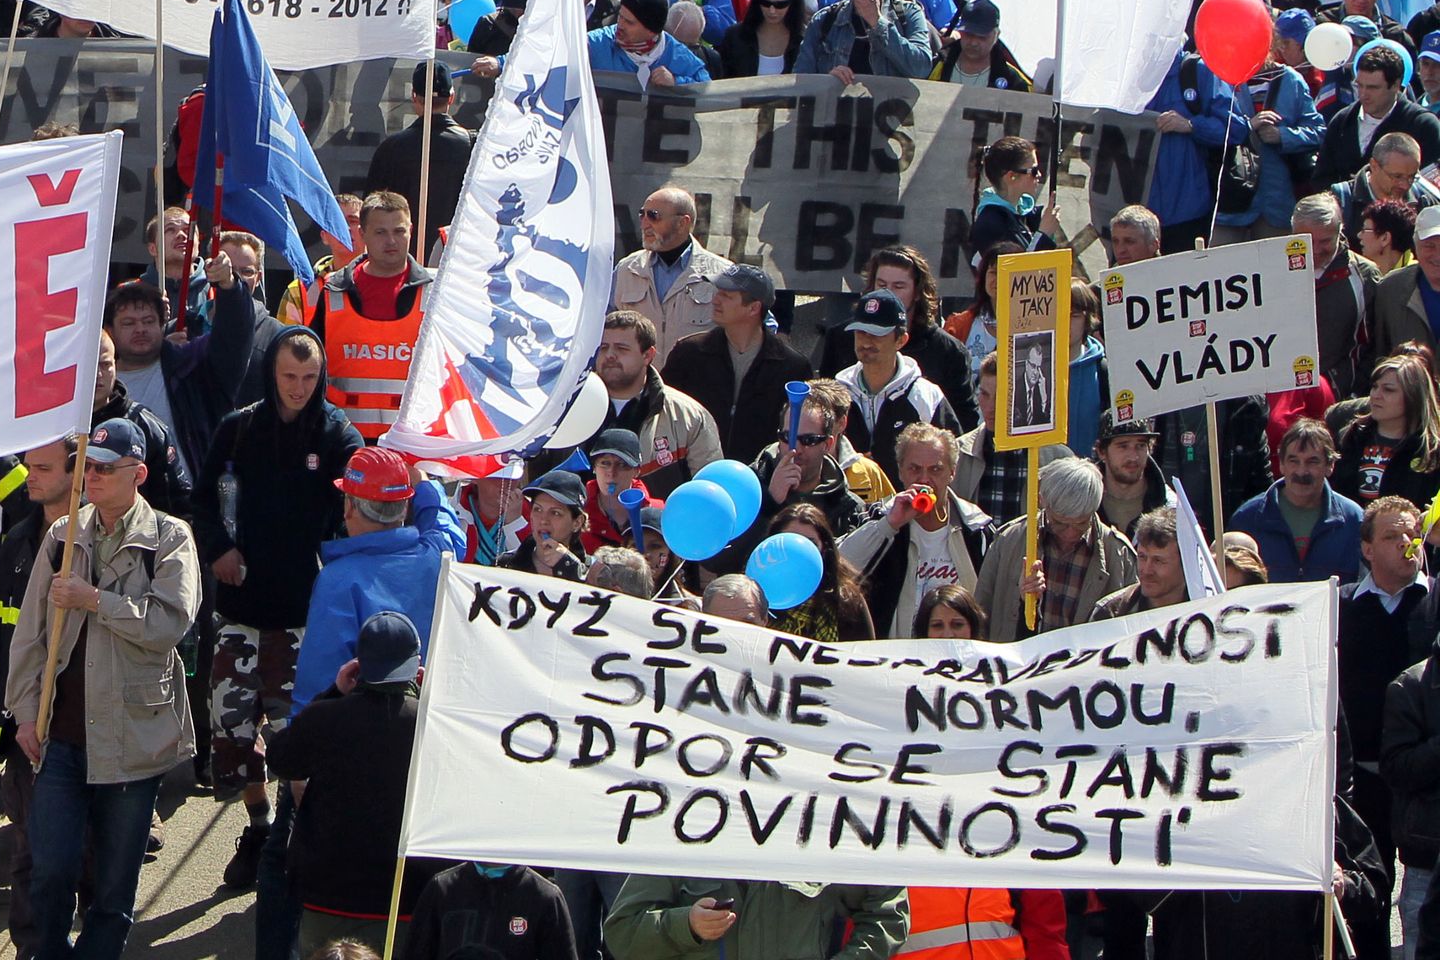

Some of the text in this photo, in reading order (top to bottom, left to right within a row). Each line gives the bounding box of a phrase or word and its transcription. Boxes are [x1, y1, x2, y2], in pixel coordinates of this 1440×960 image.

[536, 131, 561, 165] SVAZ
[740, 95, 917, 174] THIS
[1010, 273, 1055, 298] MY VAS
[1019, 297, 1053, 318] TAKY
[1125, 272, 1263, 330] DEMISI
[1135, 332, 1278, 391] VLÁDY
[468, 581, 618, 639] KDYŽ
[646, 607, 728, 655] SE
[580, 652, 1202, 734] STANE NORMOU,
[500, 711, 1247, 803] ODPOR SE STANE
